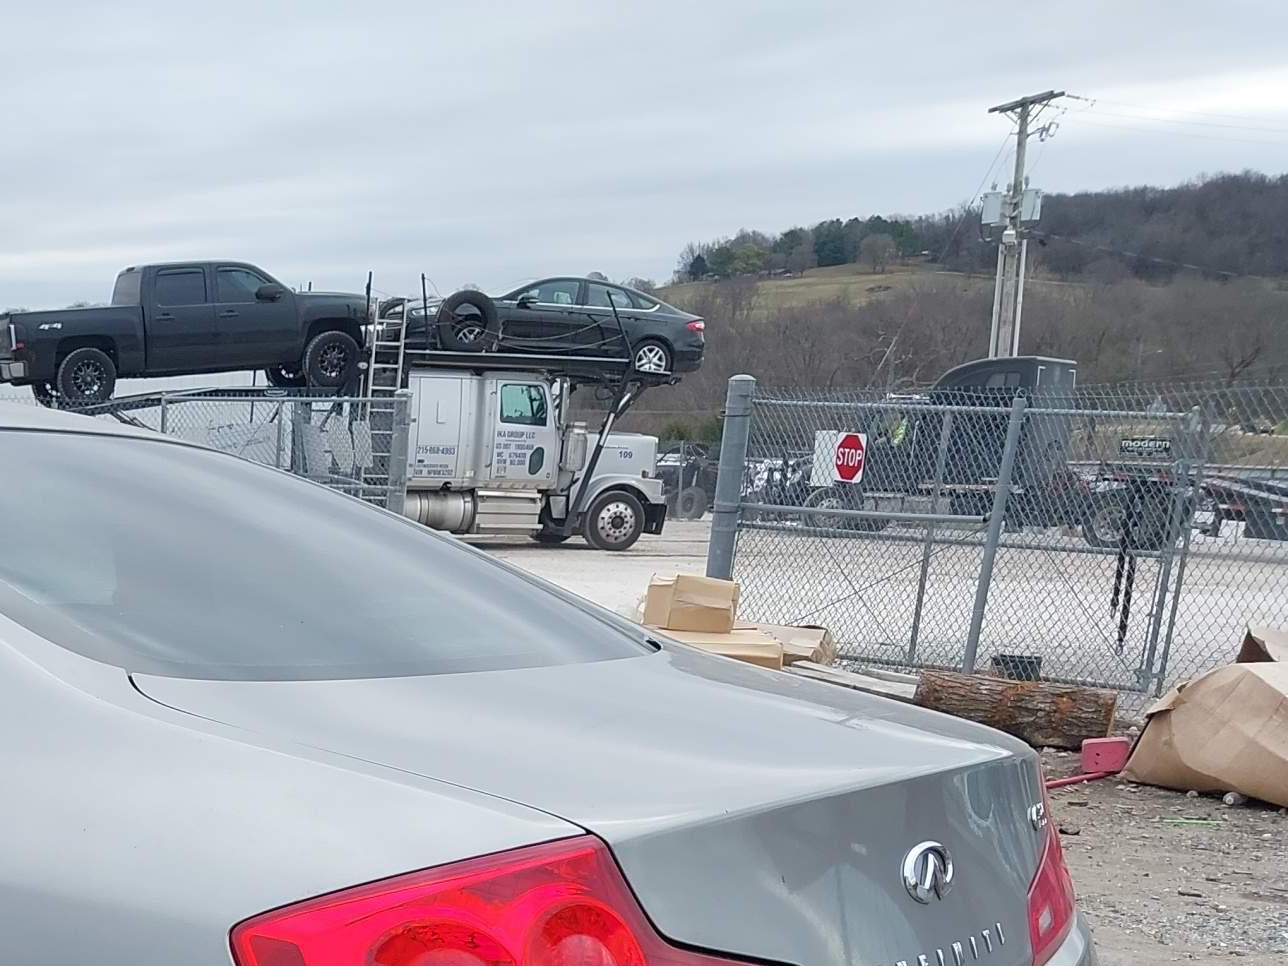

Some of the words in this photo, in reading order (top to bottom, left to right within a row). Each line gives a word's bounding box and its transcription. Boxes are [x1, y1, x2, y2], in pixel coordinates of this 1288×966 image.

[1121, 439, 1171, 449] modern
[619, 450, 633, 459] 109
[836, 447, 863, 467] STOP
